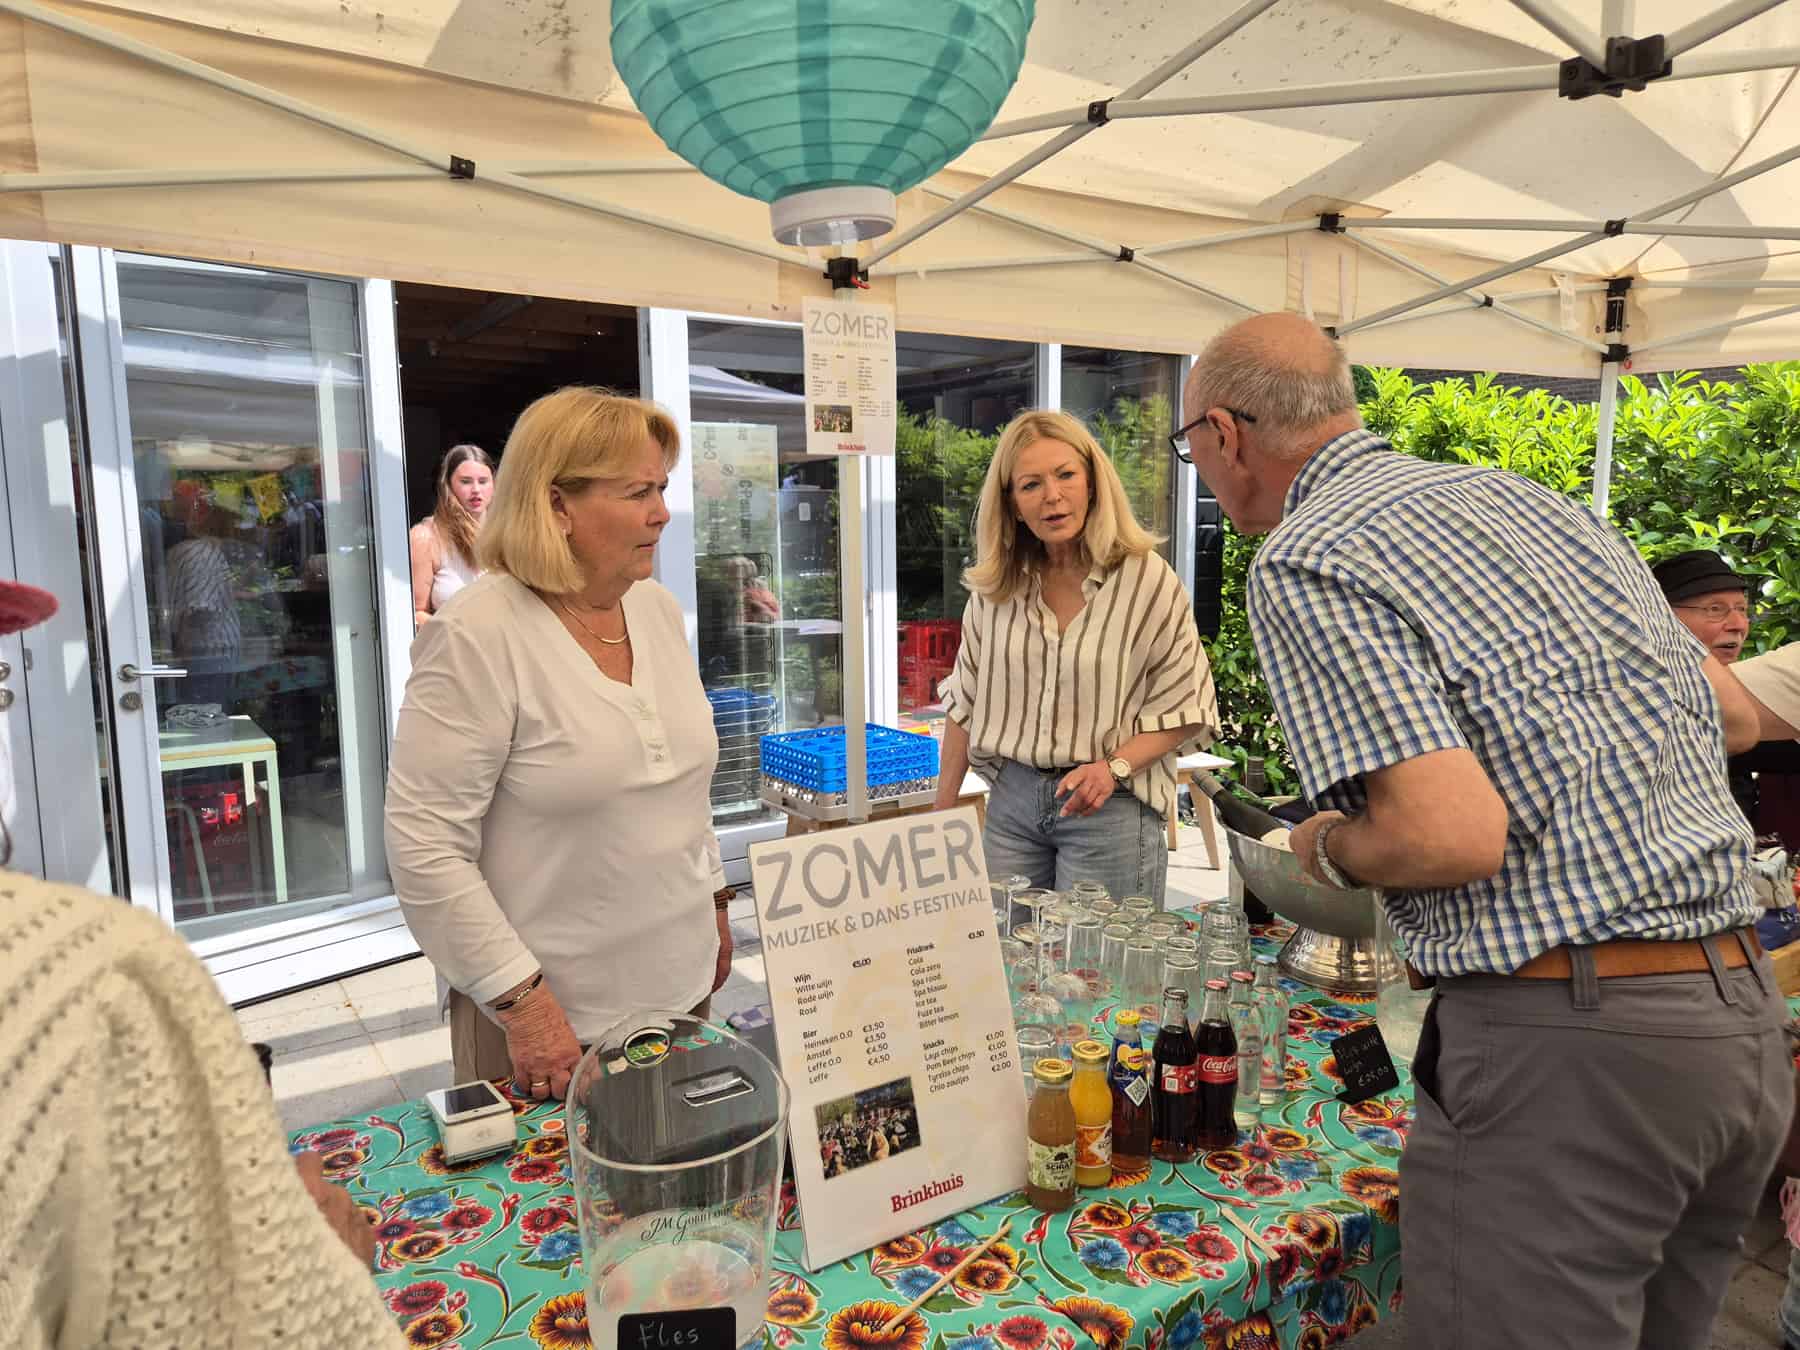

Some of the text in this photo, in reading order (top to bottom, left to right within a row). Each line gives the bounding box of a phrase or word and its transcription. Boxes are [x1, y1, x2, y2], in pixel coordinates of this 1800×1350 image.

[809, 309, 888, 340] ZOMER
[756, 818, 981, 921] ZOMER
[765, 887, 988, 951] MUZIEK & DANS FESTIVAL
[908, 956, 924, 966] Cola
[911, 963, 942, 977] Cola zero
[793, 973, 811, 984] Wijn
[912, 973, 942, 988] Spa rood
[795, 978, 833, 994] Witte wijn
[797, 990, 834, 1005] Rode wijn
[914, 988, 927, 998] Spa
[926, 997, 937, 1005] tea
[799, 1005, 817, 1017] Rosé
[934, 1005, 945, 1014] tea
[937, 1012, 960, 1024] lemon
[802, 1030, 817, 1040] Bier
[804, 1035, 839, 1050] Heineken
[922, 1039, 945, 1050] Snacks
[806, 1047, 832, 1061] Amstel
[940, 1045, 959, 1056] chips
[958, 1050, 976, 1062] chips
[808, 1061, 827, 1073] Leffe
[951, 1063, 970, 1075] chips
[808, 1071, 829, 1085] Leffe
[890, 1173, 965, 1213] Brinkhuis
[638, 1319, 699, 1350] Fles
